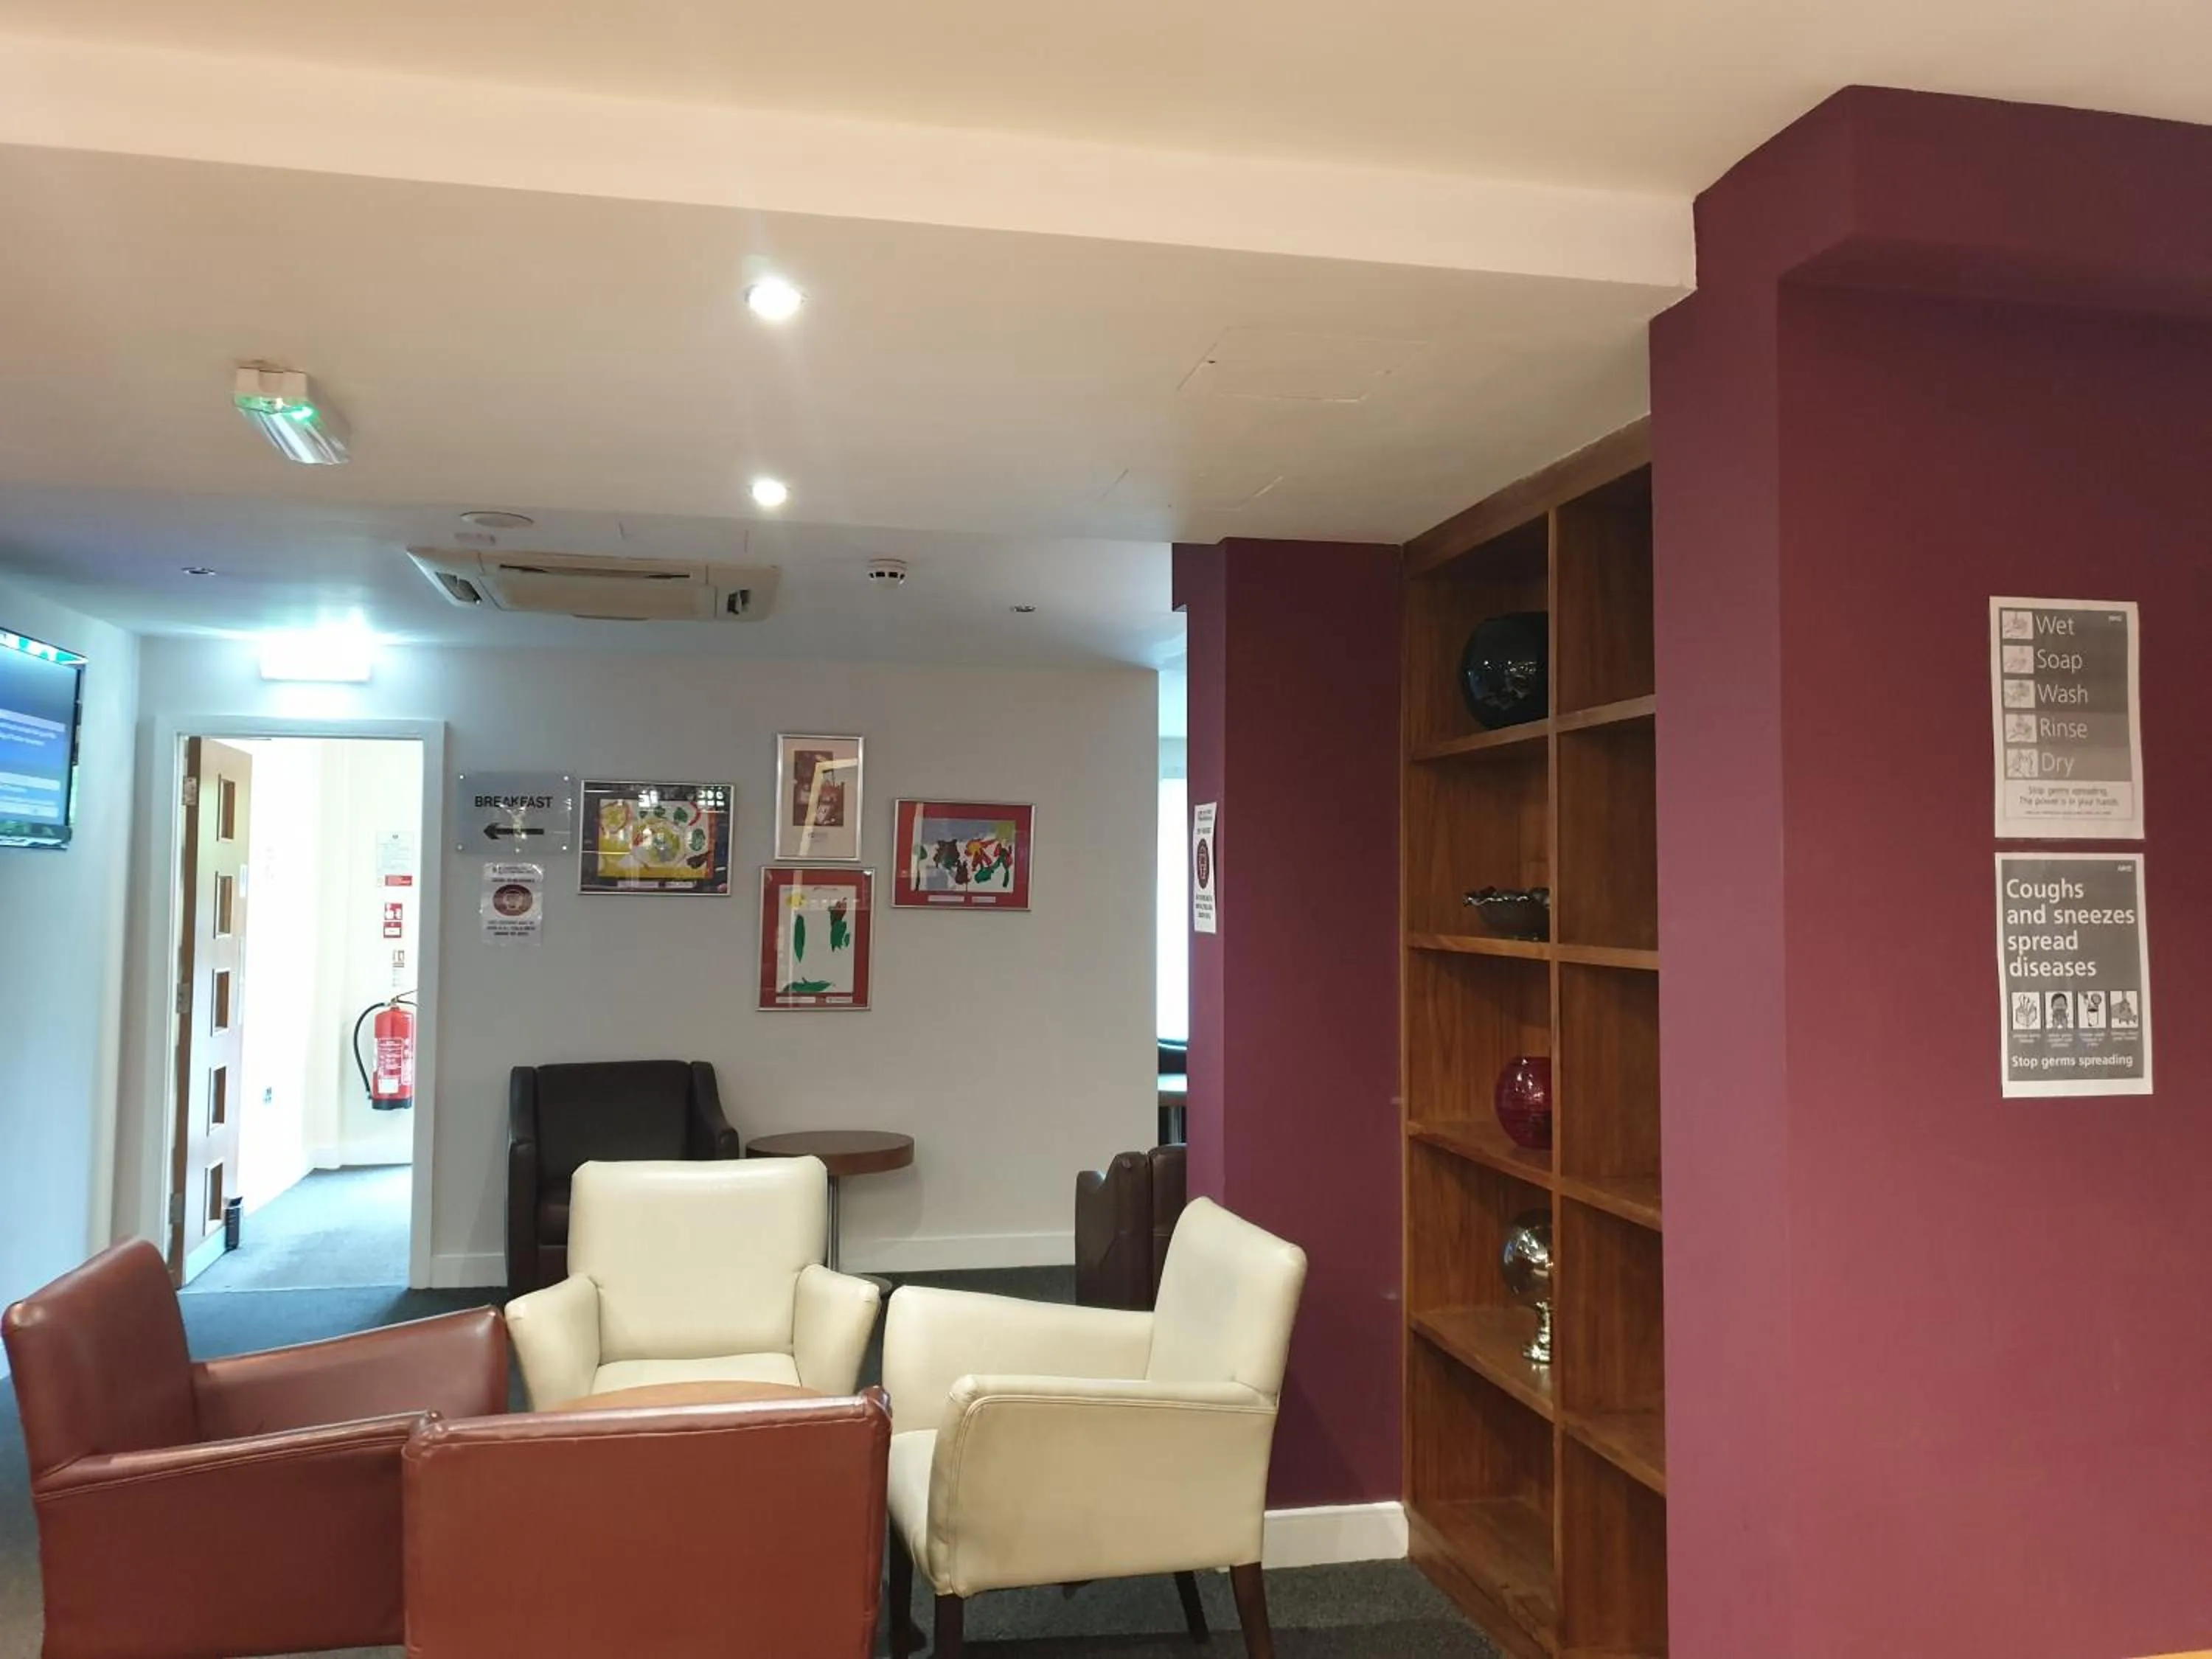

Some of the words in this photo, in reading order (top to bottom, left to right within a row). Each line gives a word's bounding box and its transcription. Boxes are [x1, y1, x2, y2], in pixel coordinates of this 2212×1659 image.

[2036, 616, 2075, 636] Wet
[2037, 649, 2083, 672] Soap
[2038, 684, 2088, 703] Wash
[2039, 718, 2088, 738] Rinse
[2041, 753, 2075, 776] Dry
[474, 796, 554, 808] BREAKFAST
[2006, 878, 2084, 903] Coughs
[2006, 904, 2046, 925] and
[2053, 908, 2135, 925] sneezes
[2008, 931, 2079, 955] spread
[2009, 956, 2097, 977] diseases
[2011, 1055, 2038, 1069] Stop
[2041, 1057, 2076, 1069] germs
[2079, 1054, 2133, 1068] spreading
